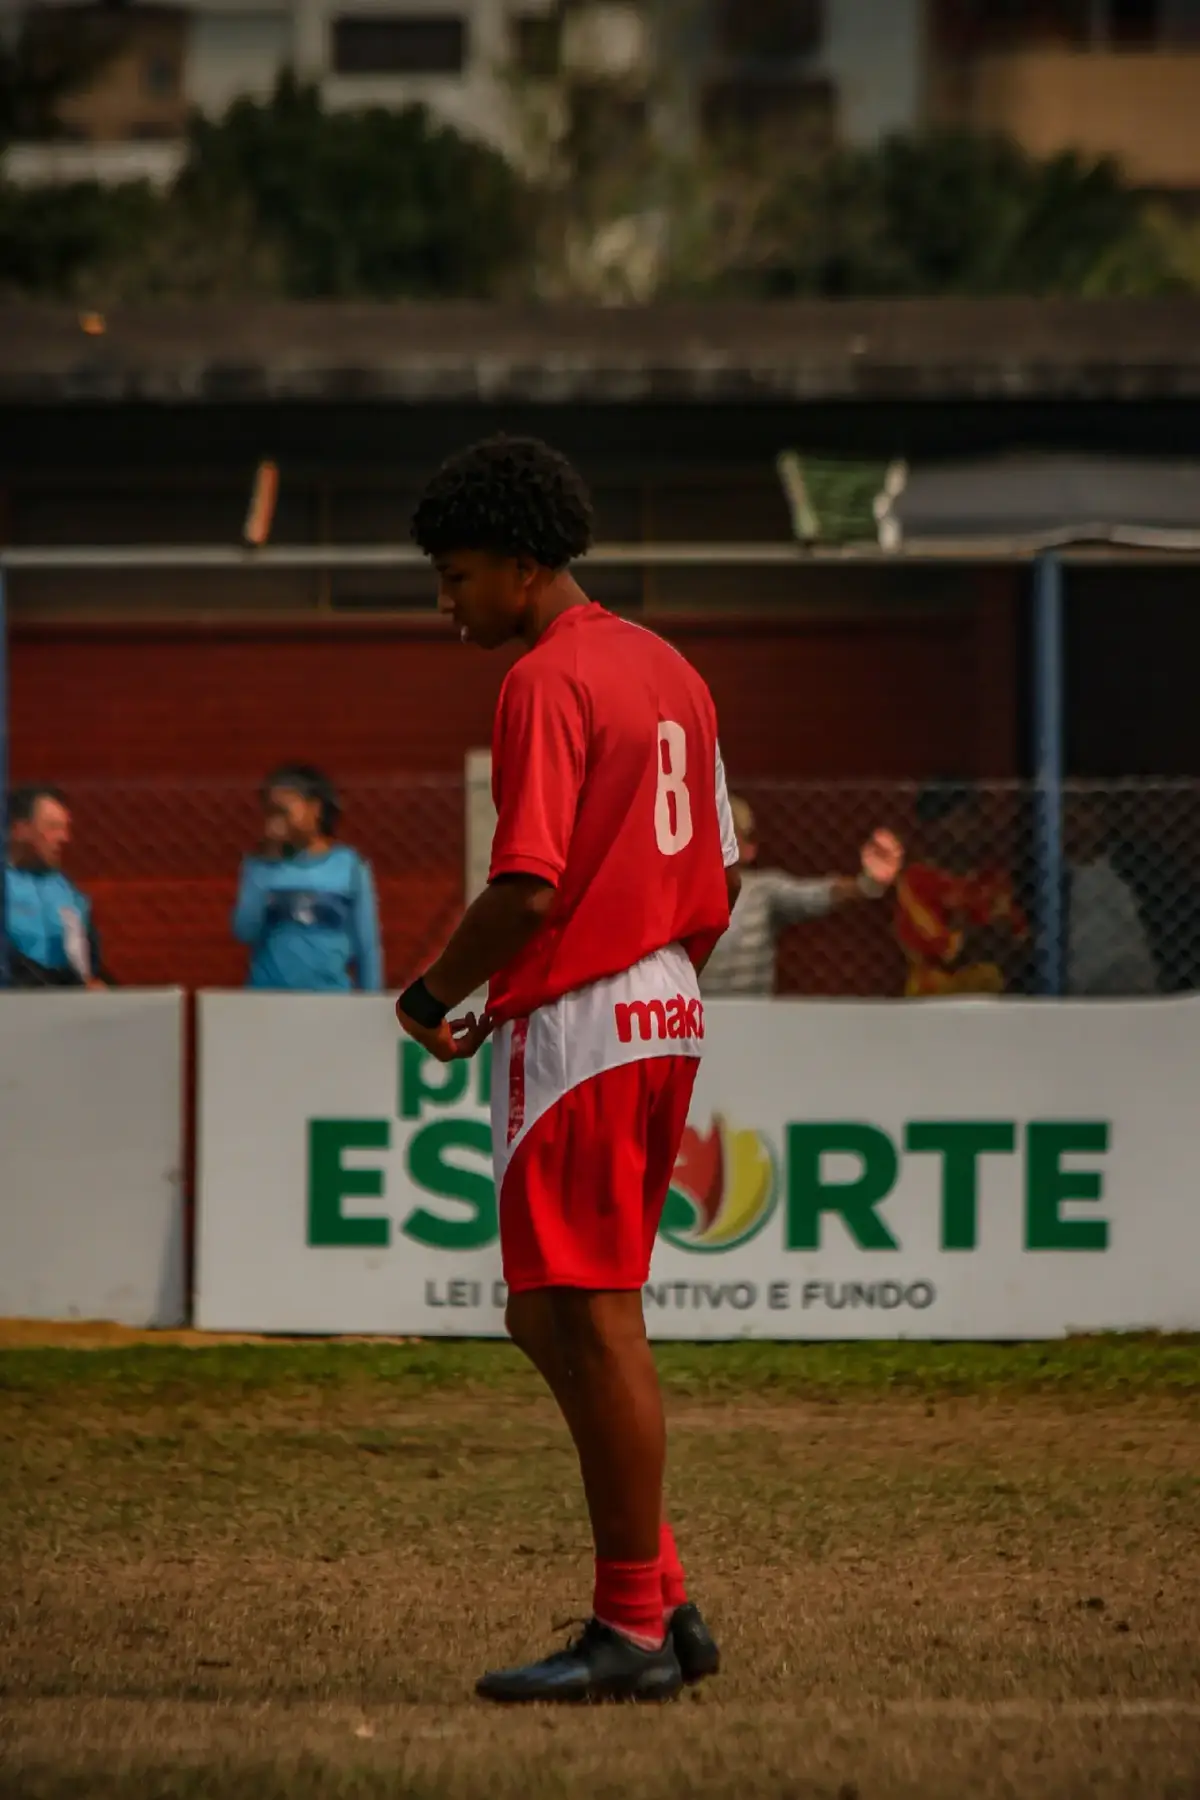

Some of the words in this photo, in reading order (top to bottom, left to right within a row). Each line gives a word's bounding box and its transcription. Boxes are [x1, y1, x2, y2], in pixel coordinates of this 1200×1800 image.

[654, 720, 693, 856] 8
[424, 1279, 481, 1309] LEI
[767, 1281, 790, 1310] E
[802, 1279, 937, 1310] FUNDO
